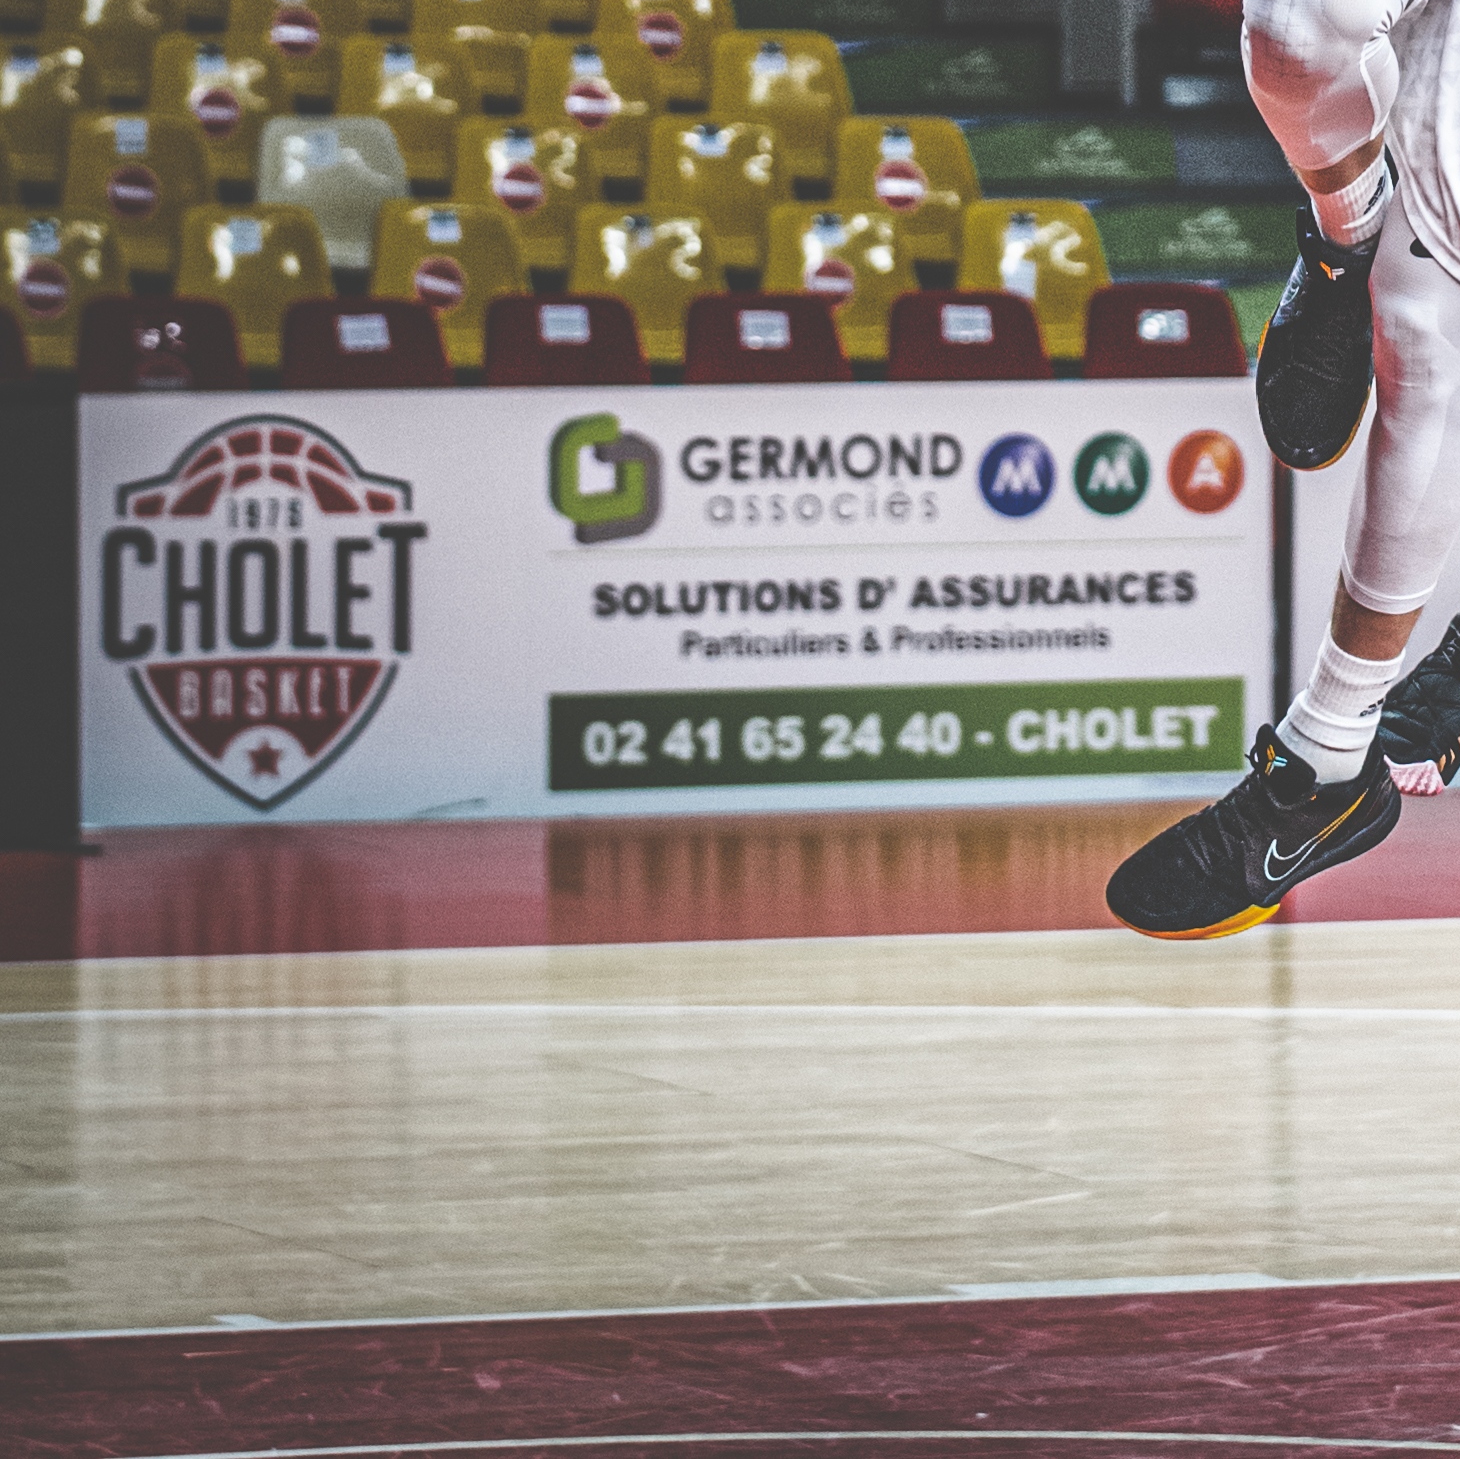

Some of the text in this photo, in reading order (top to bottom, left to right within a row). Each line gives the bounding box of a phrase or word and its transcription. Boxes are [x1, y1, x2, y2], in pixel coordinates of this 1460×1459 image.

[679, 432, 963, 484] GERMOND
[704, 481, 940, 525] associés
[102, 522, 428, 661] CHOLET
[593, 570, 1197, 617] SOLUTIONS D' ASSURANCES
[680, 622, 1110, 657] Particuliers & Professionnels
[179, 667, 355, 719] BASKET
[583, 720, 648, 764] 02
[661, 717, 722, 761] 41
[741, 715, 805, 761] 65
[819, 711, 884, 758] 24
[897, 711, 962, 755] 40
[1008, 704, 1218, 753] CHOLET
